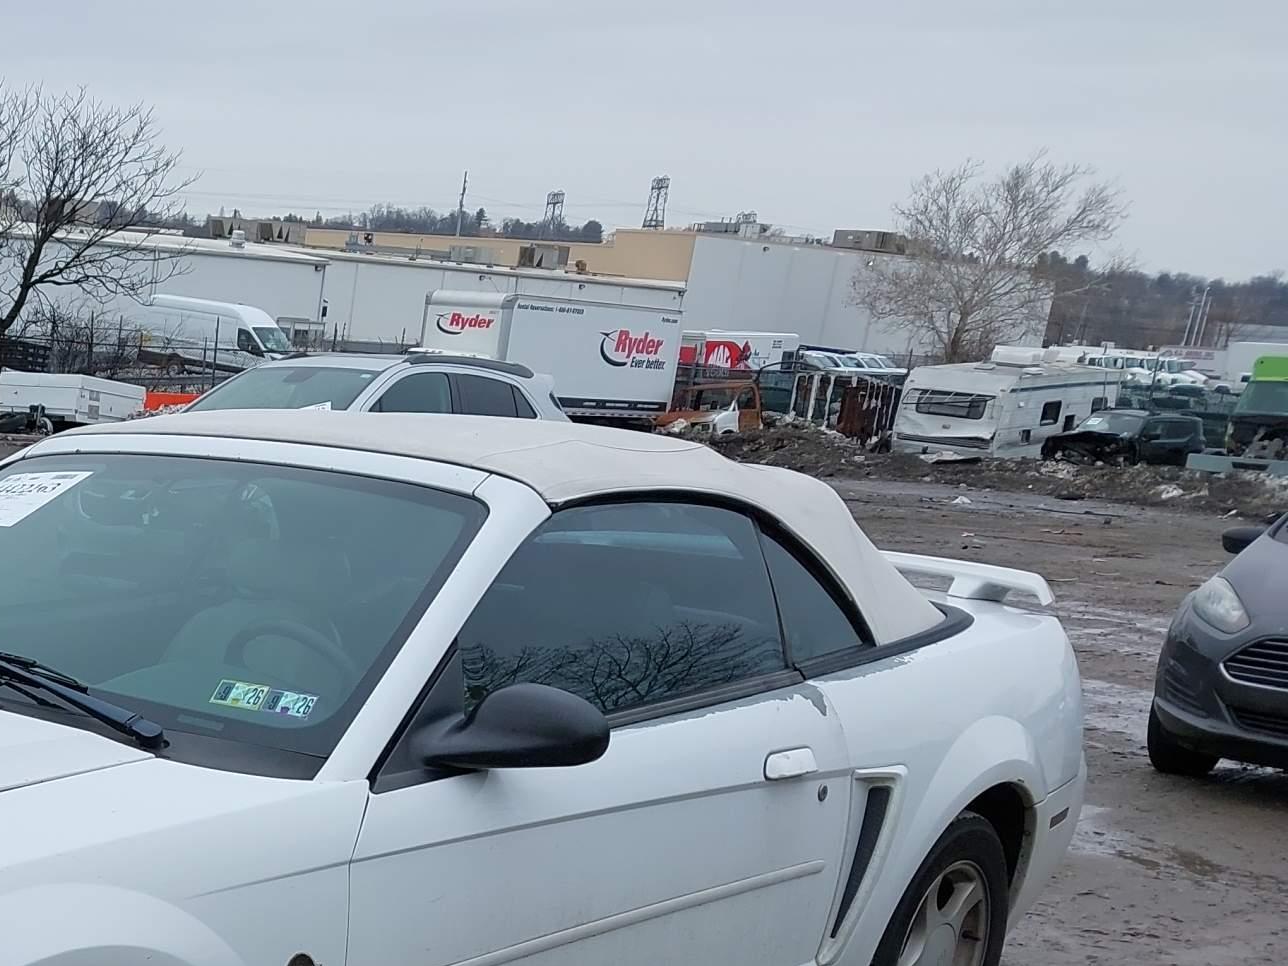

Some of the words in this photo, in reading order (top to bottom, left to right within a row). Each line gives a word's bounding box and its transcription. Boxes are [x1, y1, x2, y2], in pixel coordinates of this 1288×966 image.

[449, 312, 495, 330] Ryder
[615, 329, 664, 359] Ryder
[630, 356, 646, 369] Ever
[246, 687, 264, 706] 26
[296, 697, 314, 715] 26
